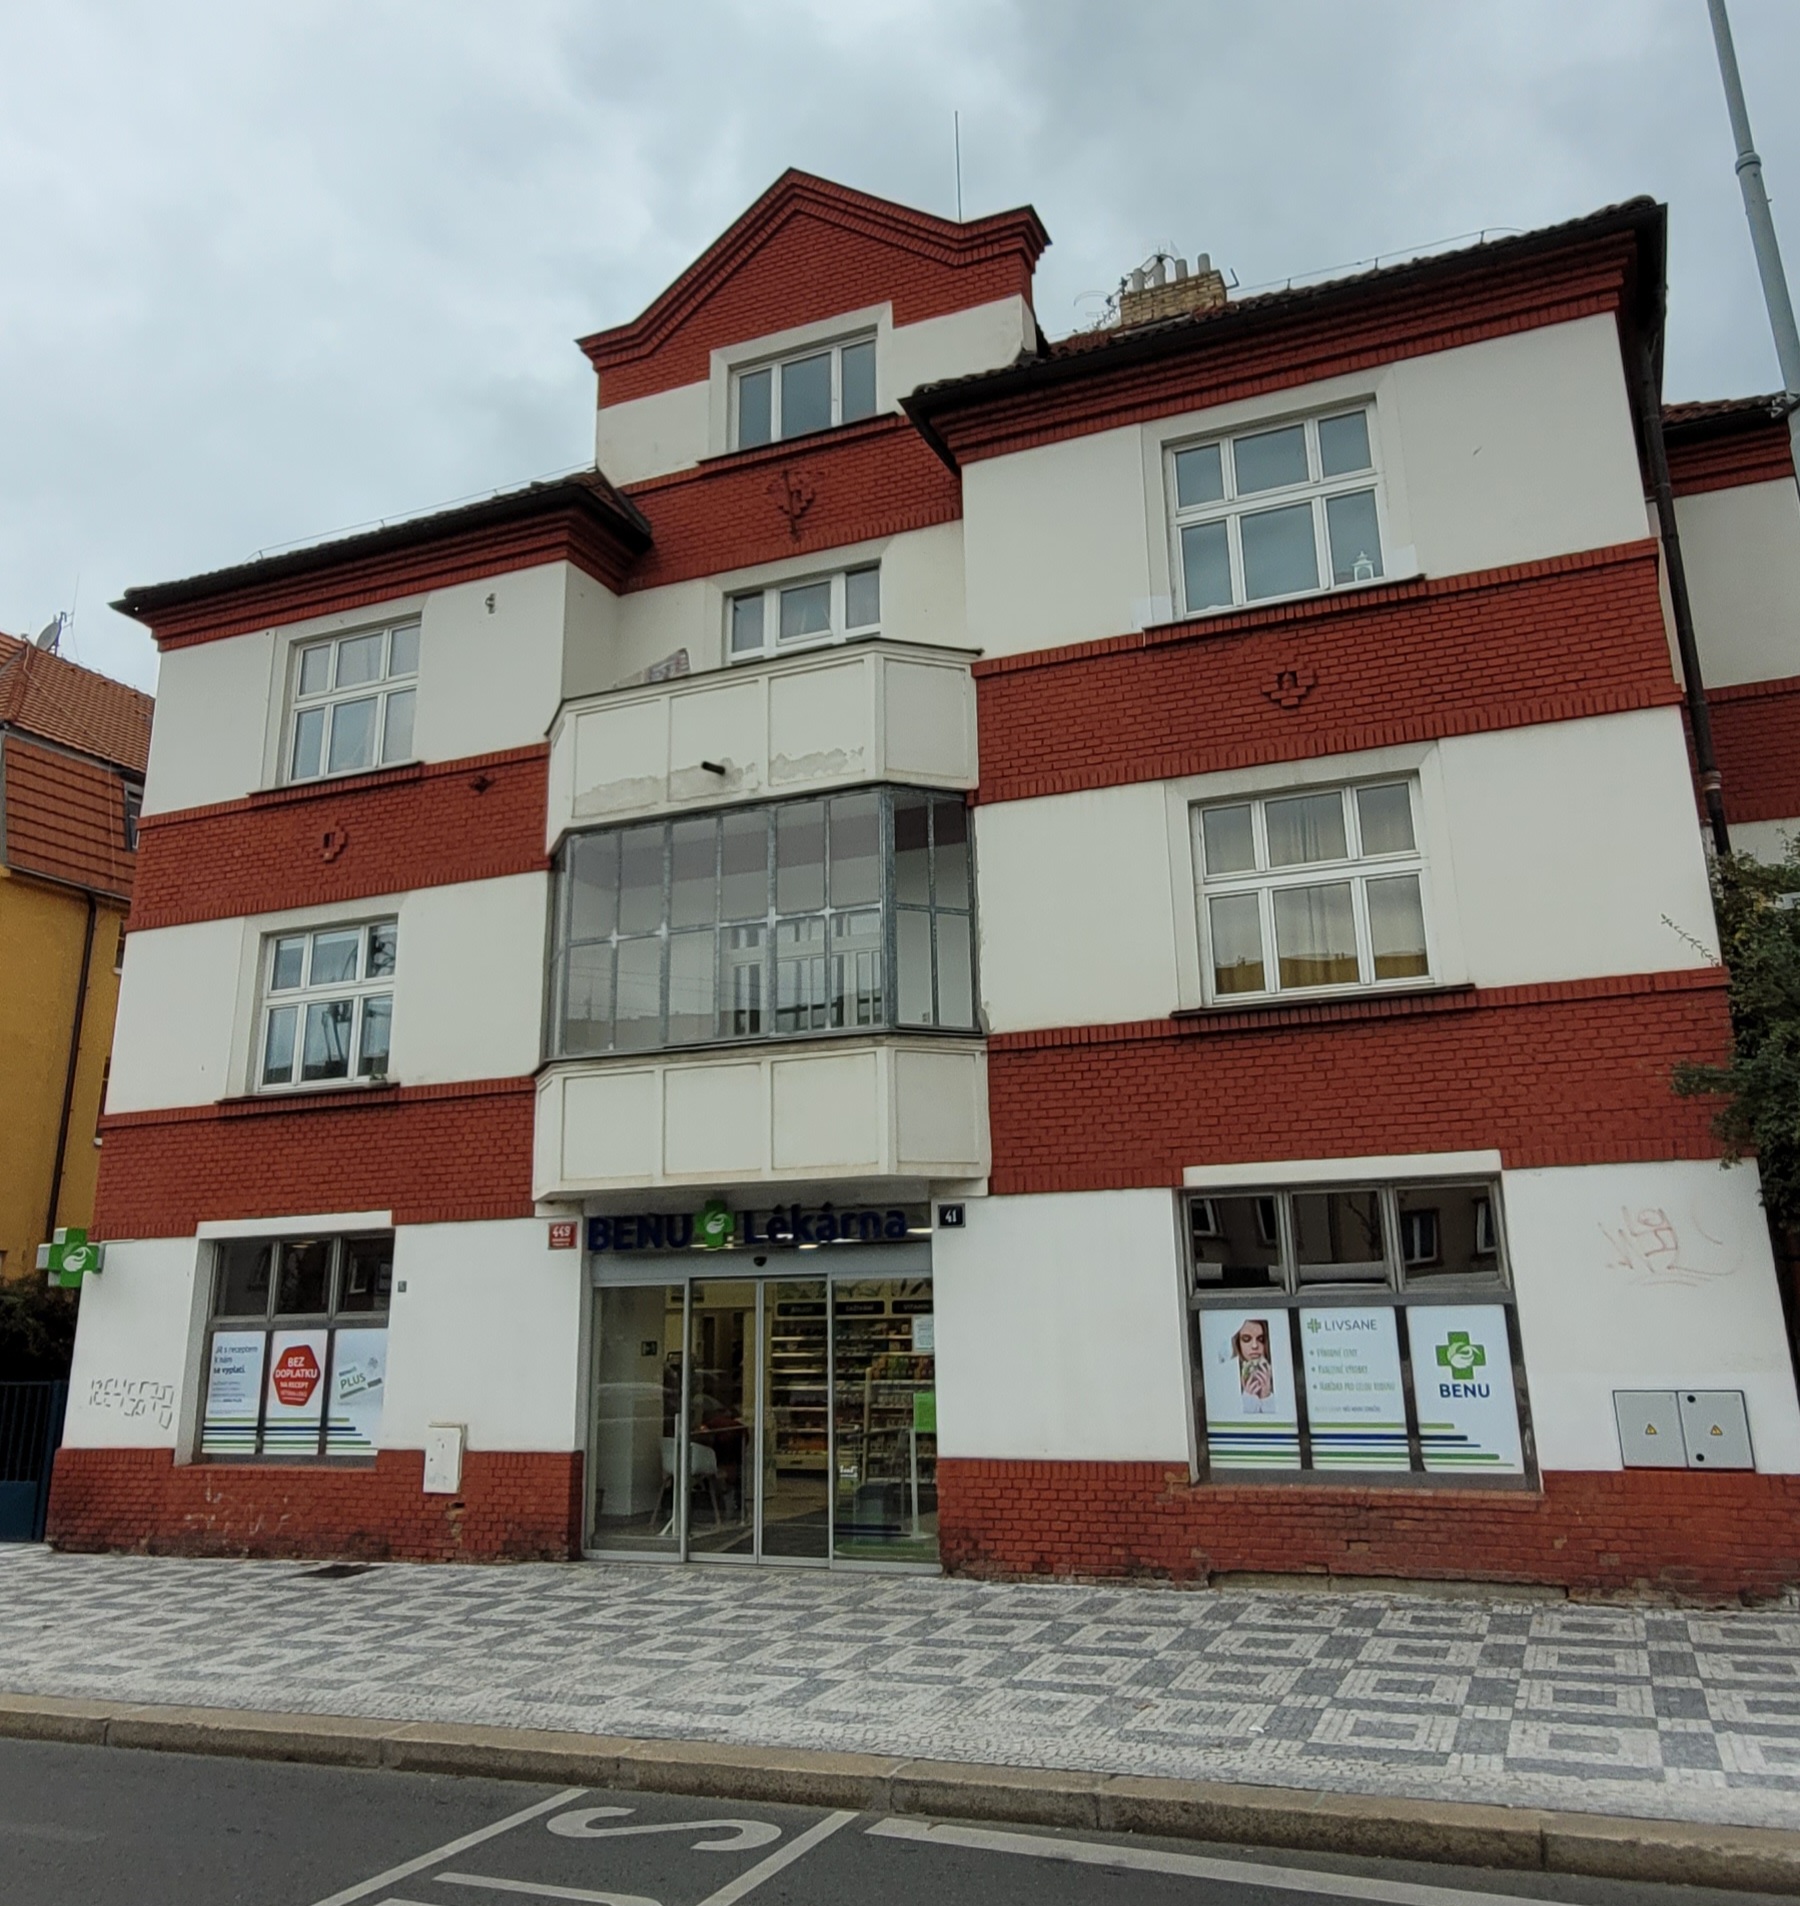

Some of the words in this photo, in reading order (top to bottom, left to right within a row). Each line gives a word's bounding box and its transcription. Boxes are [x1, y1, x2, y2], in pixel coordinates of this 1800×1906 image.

[945, 1209, 957, 1223] 41
[553, 1225, 571, 1238] 449
[588, 1213, 693, 1251] BENU
[743, 1202, 907, 1245] Lékárna
[1324, 1319, 1378, 1332] LIVSANE
[287, 1356, 306, 1368] BEZ
[274, 1368, 318, 1379] DOPLATKU
[340, 1373, 367, 1390] PLUS
[1439, 1383, 1491, 1399] BENU
